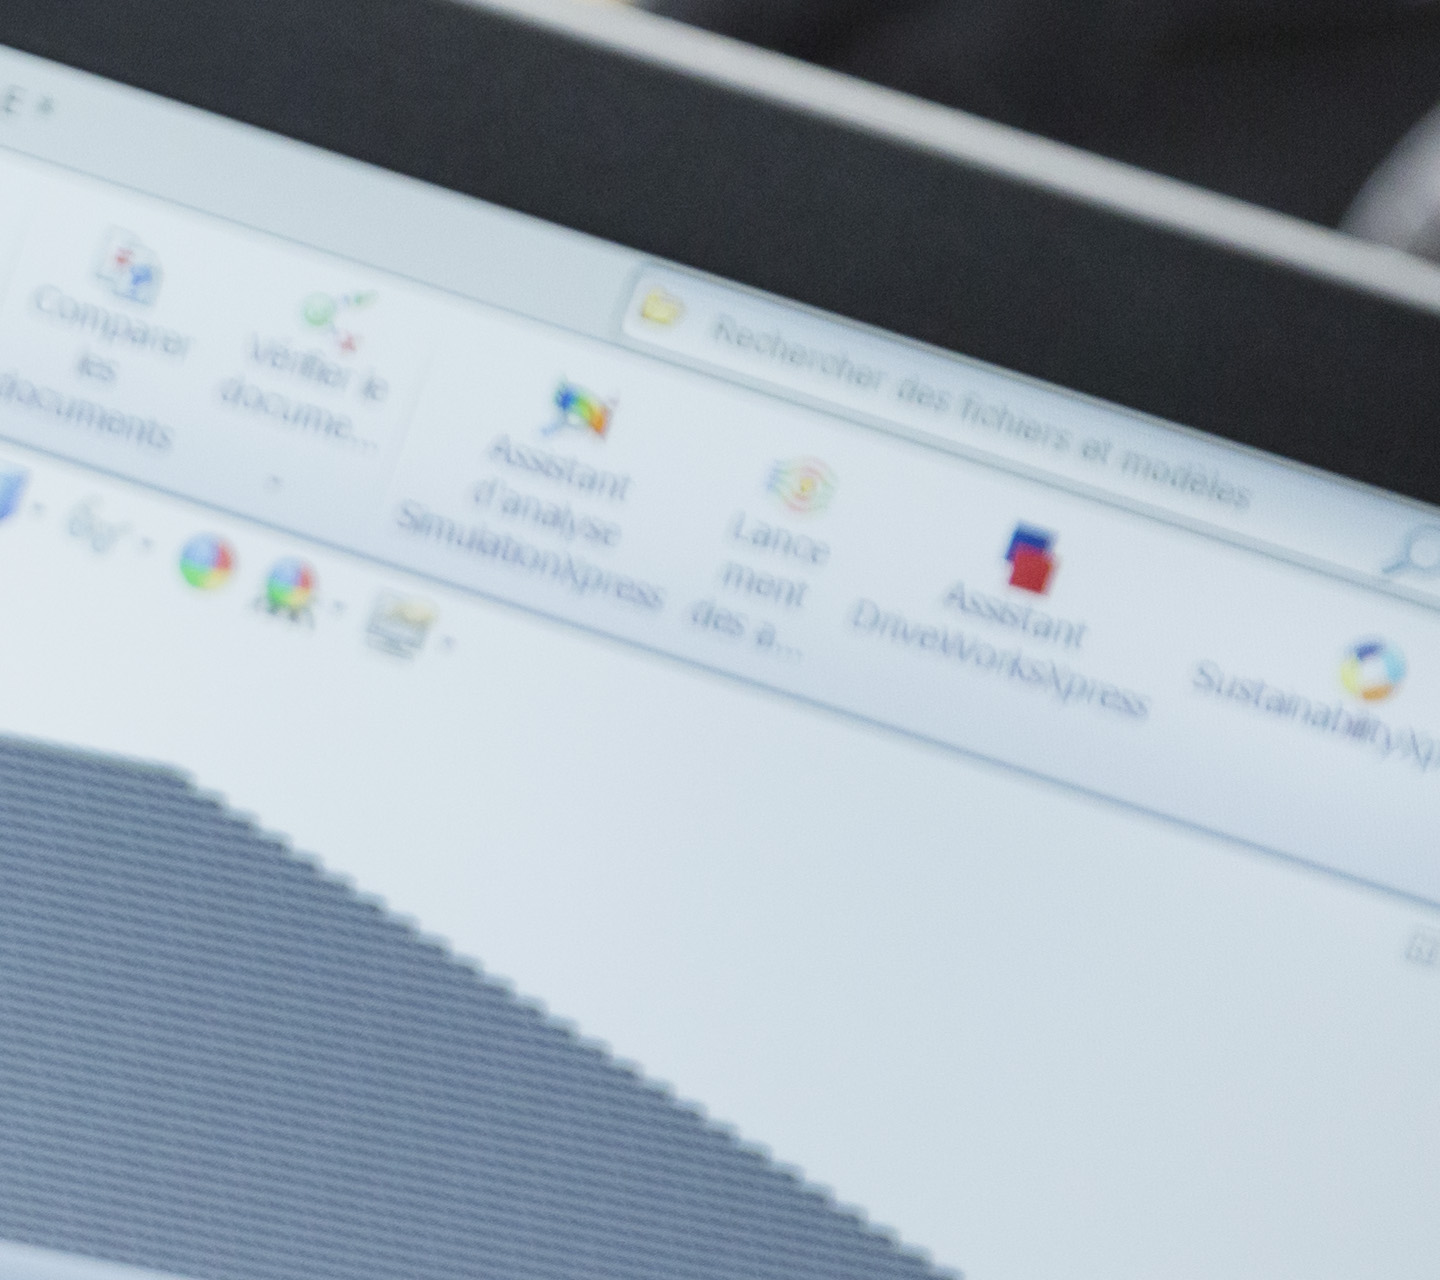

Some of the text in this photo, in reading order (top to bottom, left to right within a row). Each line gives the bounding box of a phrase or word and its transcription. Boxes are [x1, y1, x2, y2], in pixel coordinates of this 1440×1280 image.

[32, 283, 194, 361] Comparer
[75, 351, 117, 387] les
[710, 310, 1253, 511] Rechercher des fichiers et modèles
[488, 434, 631, 501] Assistant
[729, 511, 830, 566] Lance
[719, 561, 807, 609] ment
[942, 578, 1087, 650] Assistant
[688, 599, 746, 641] des
[849, 598, 1150, 720] DriveWorksXpress
[1190, 657, 1440, 773] SustainabilityXp
